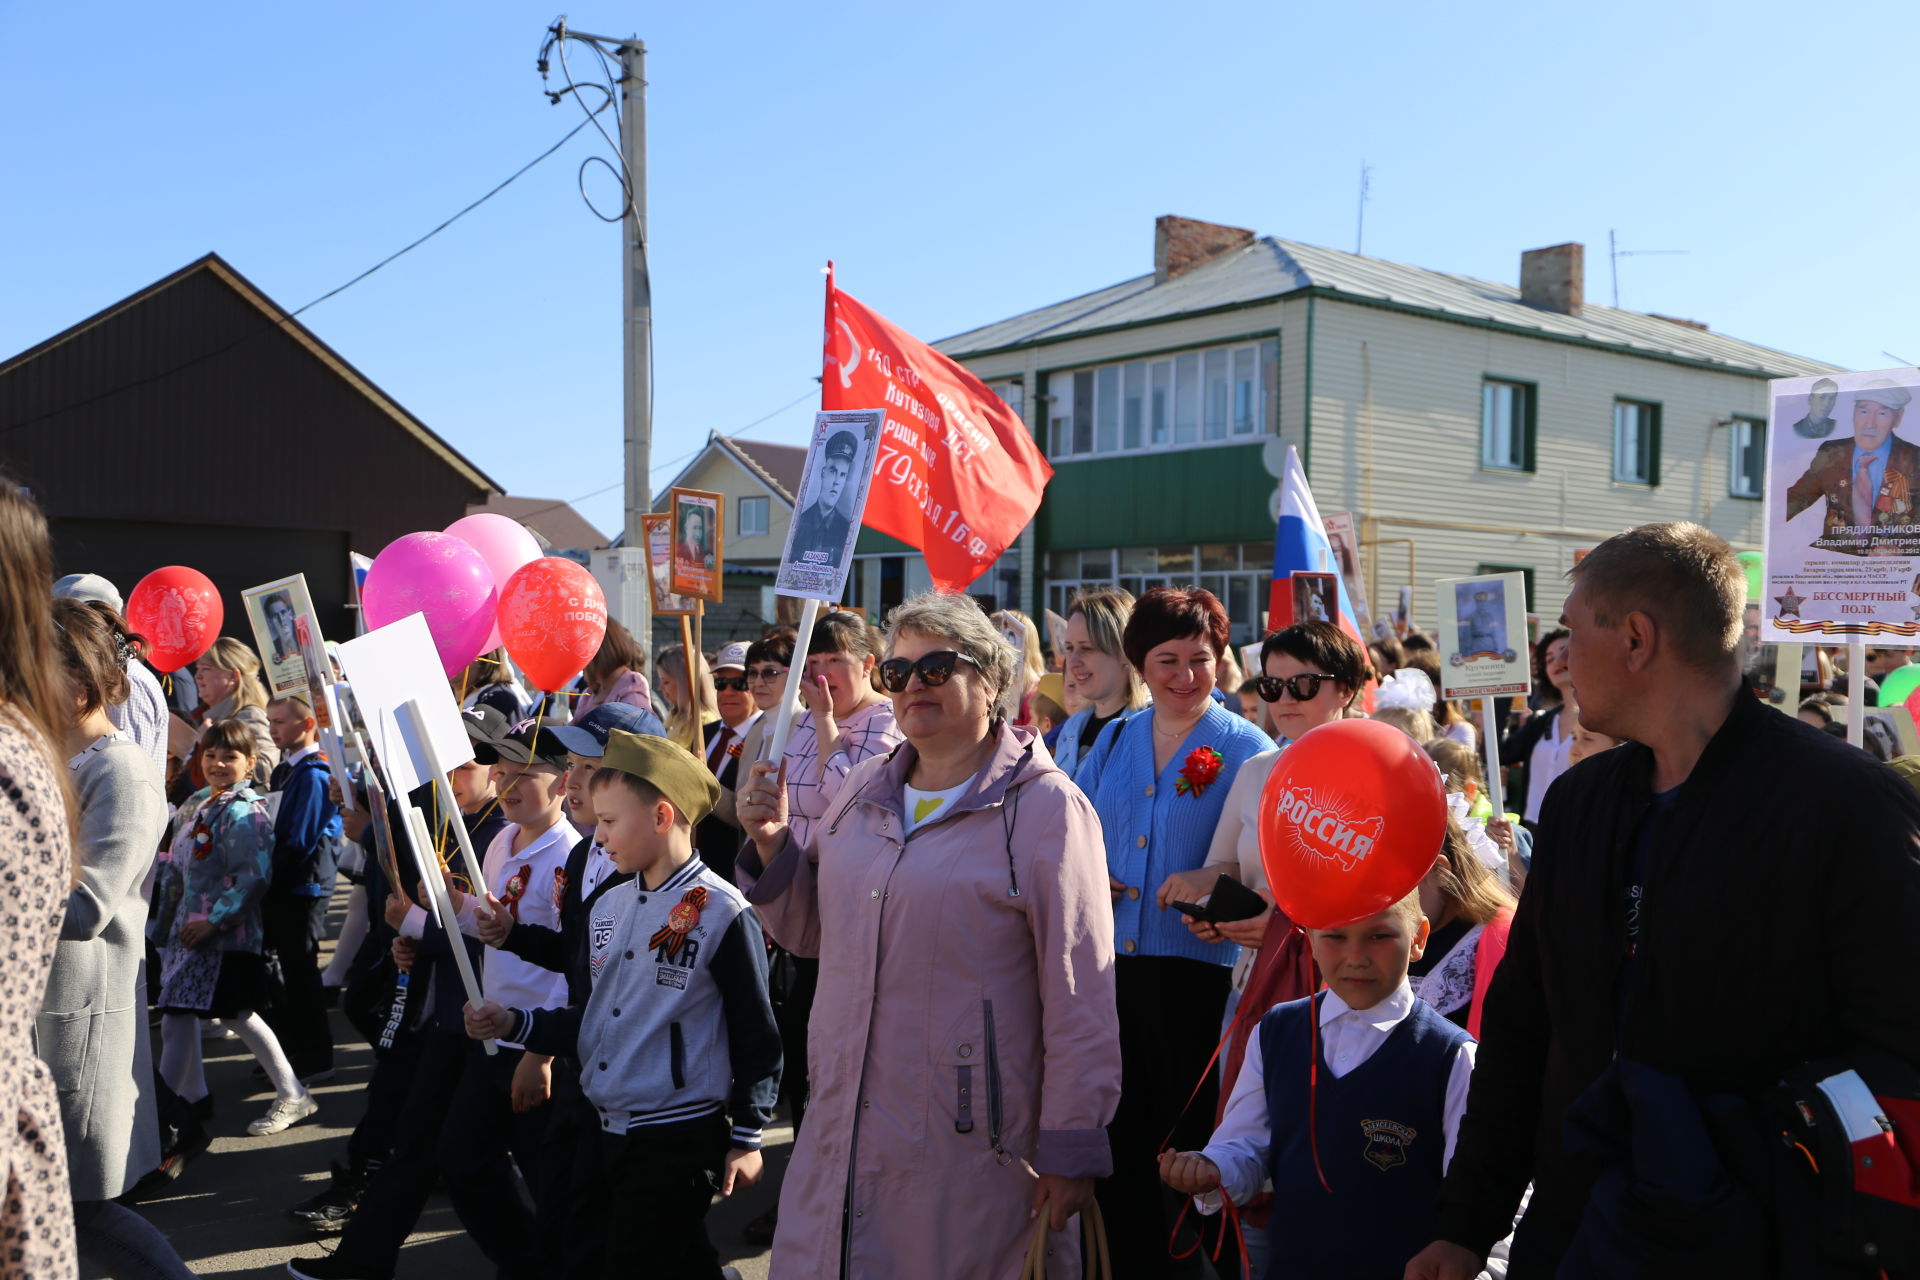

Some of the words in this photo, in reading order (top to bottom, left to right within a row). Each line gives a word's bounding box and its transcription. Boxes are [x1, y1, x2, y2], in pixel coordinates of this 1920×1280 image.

[868, 348, 892, 378] 150
[885, 380, 941, 433] КУТУЗОВА
[936, 392, 992, 452] ОРДЕНА
[883, 418, 920, 452] РИЦК.
[875, 444, 913, 485] 79
[1831, 524, 1920, 535] ПРЯДИЛЬНИКОВ
[1816, 537, 1869, 548] Владимир
[1871, 536, 1920, 548] Дмитрие
[568, 597, 579, 607] С
[1813, 590, 1907, 601] БЕССМЕРТНЫЙ
[1841, 605, 1876, 614] ПОЛК
[564, 611, 607, 631] ПОБЕД
[1279, 790, 1375, 861] РОССИЯ
[594, 930, 612, 945] 03
[1373, 1133, 1401, 1147] ШКОЛА
